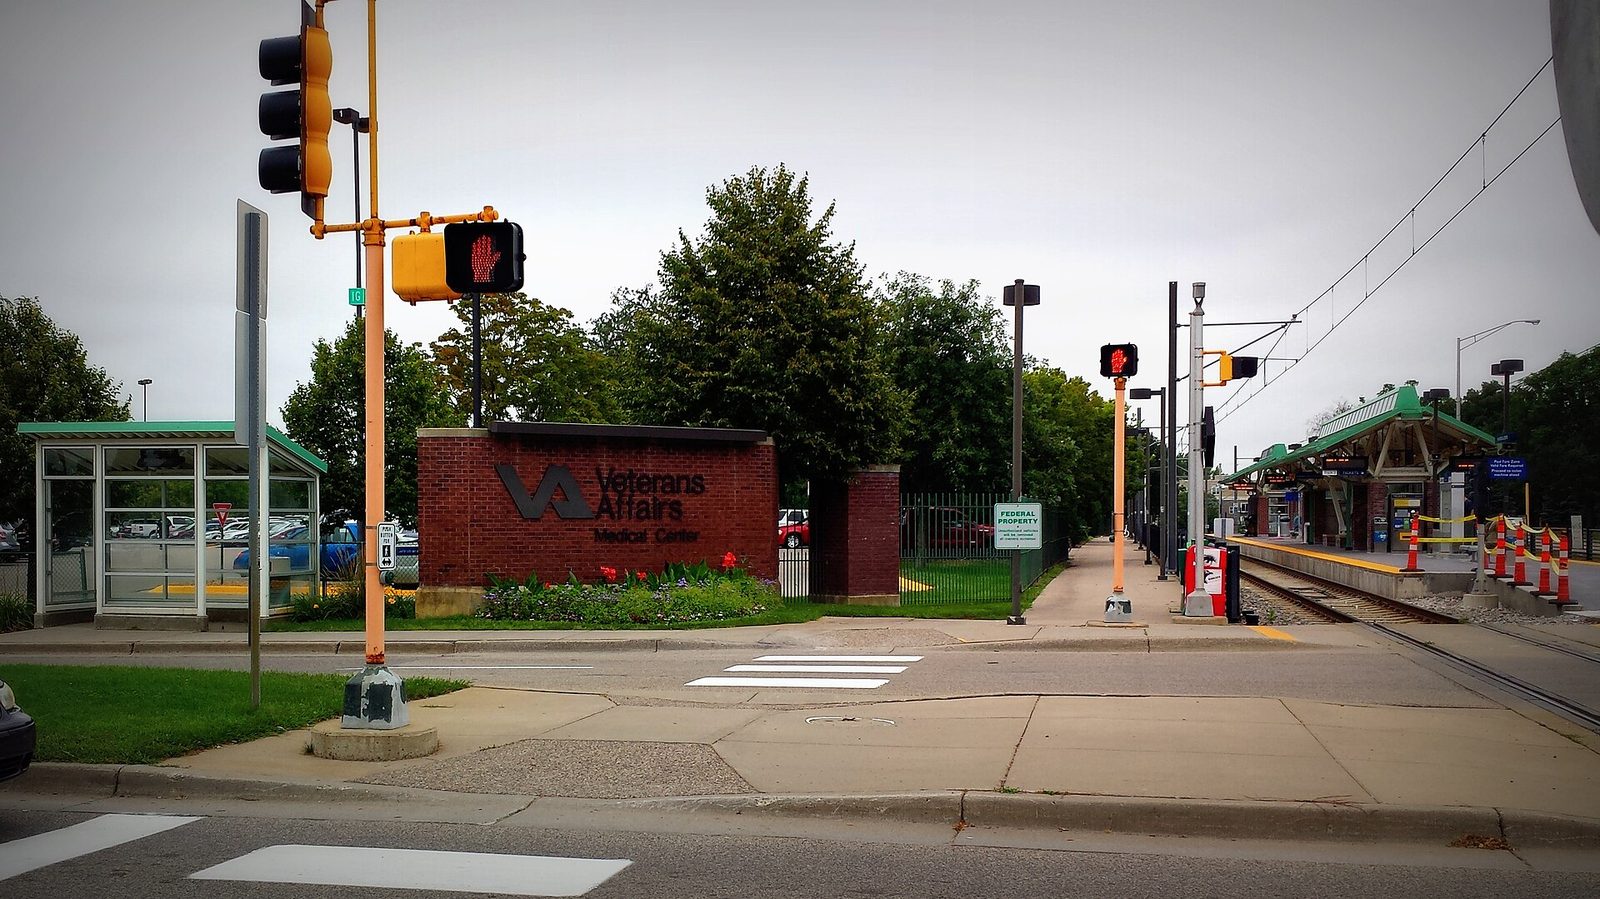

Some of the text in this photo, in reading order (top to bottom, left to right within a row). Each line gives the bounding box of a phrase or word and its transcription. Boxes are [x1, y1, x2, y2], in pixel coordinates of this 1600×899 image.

[595, 466, 705, 494] Veterans
[595, 495, 683, 520] Affairs
[594, 528, 699, 543] Medical Center
